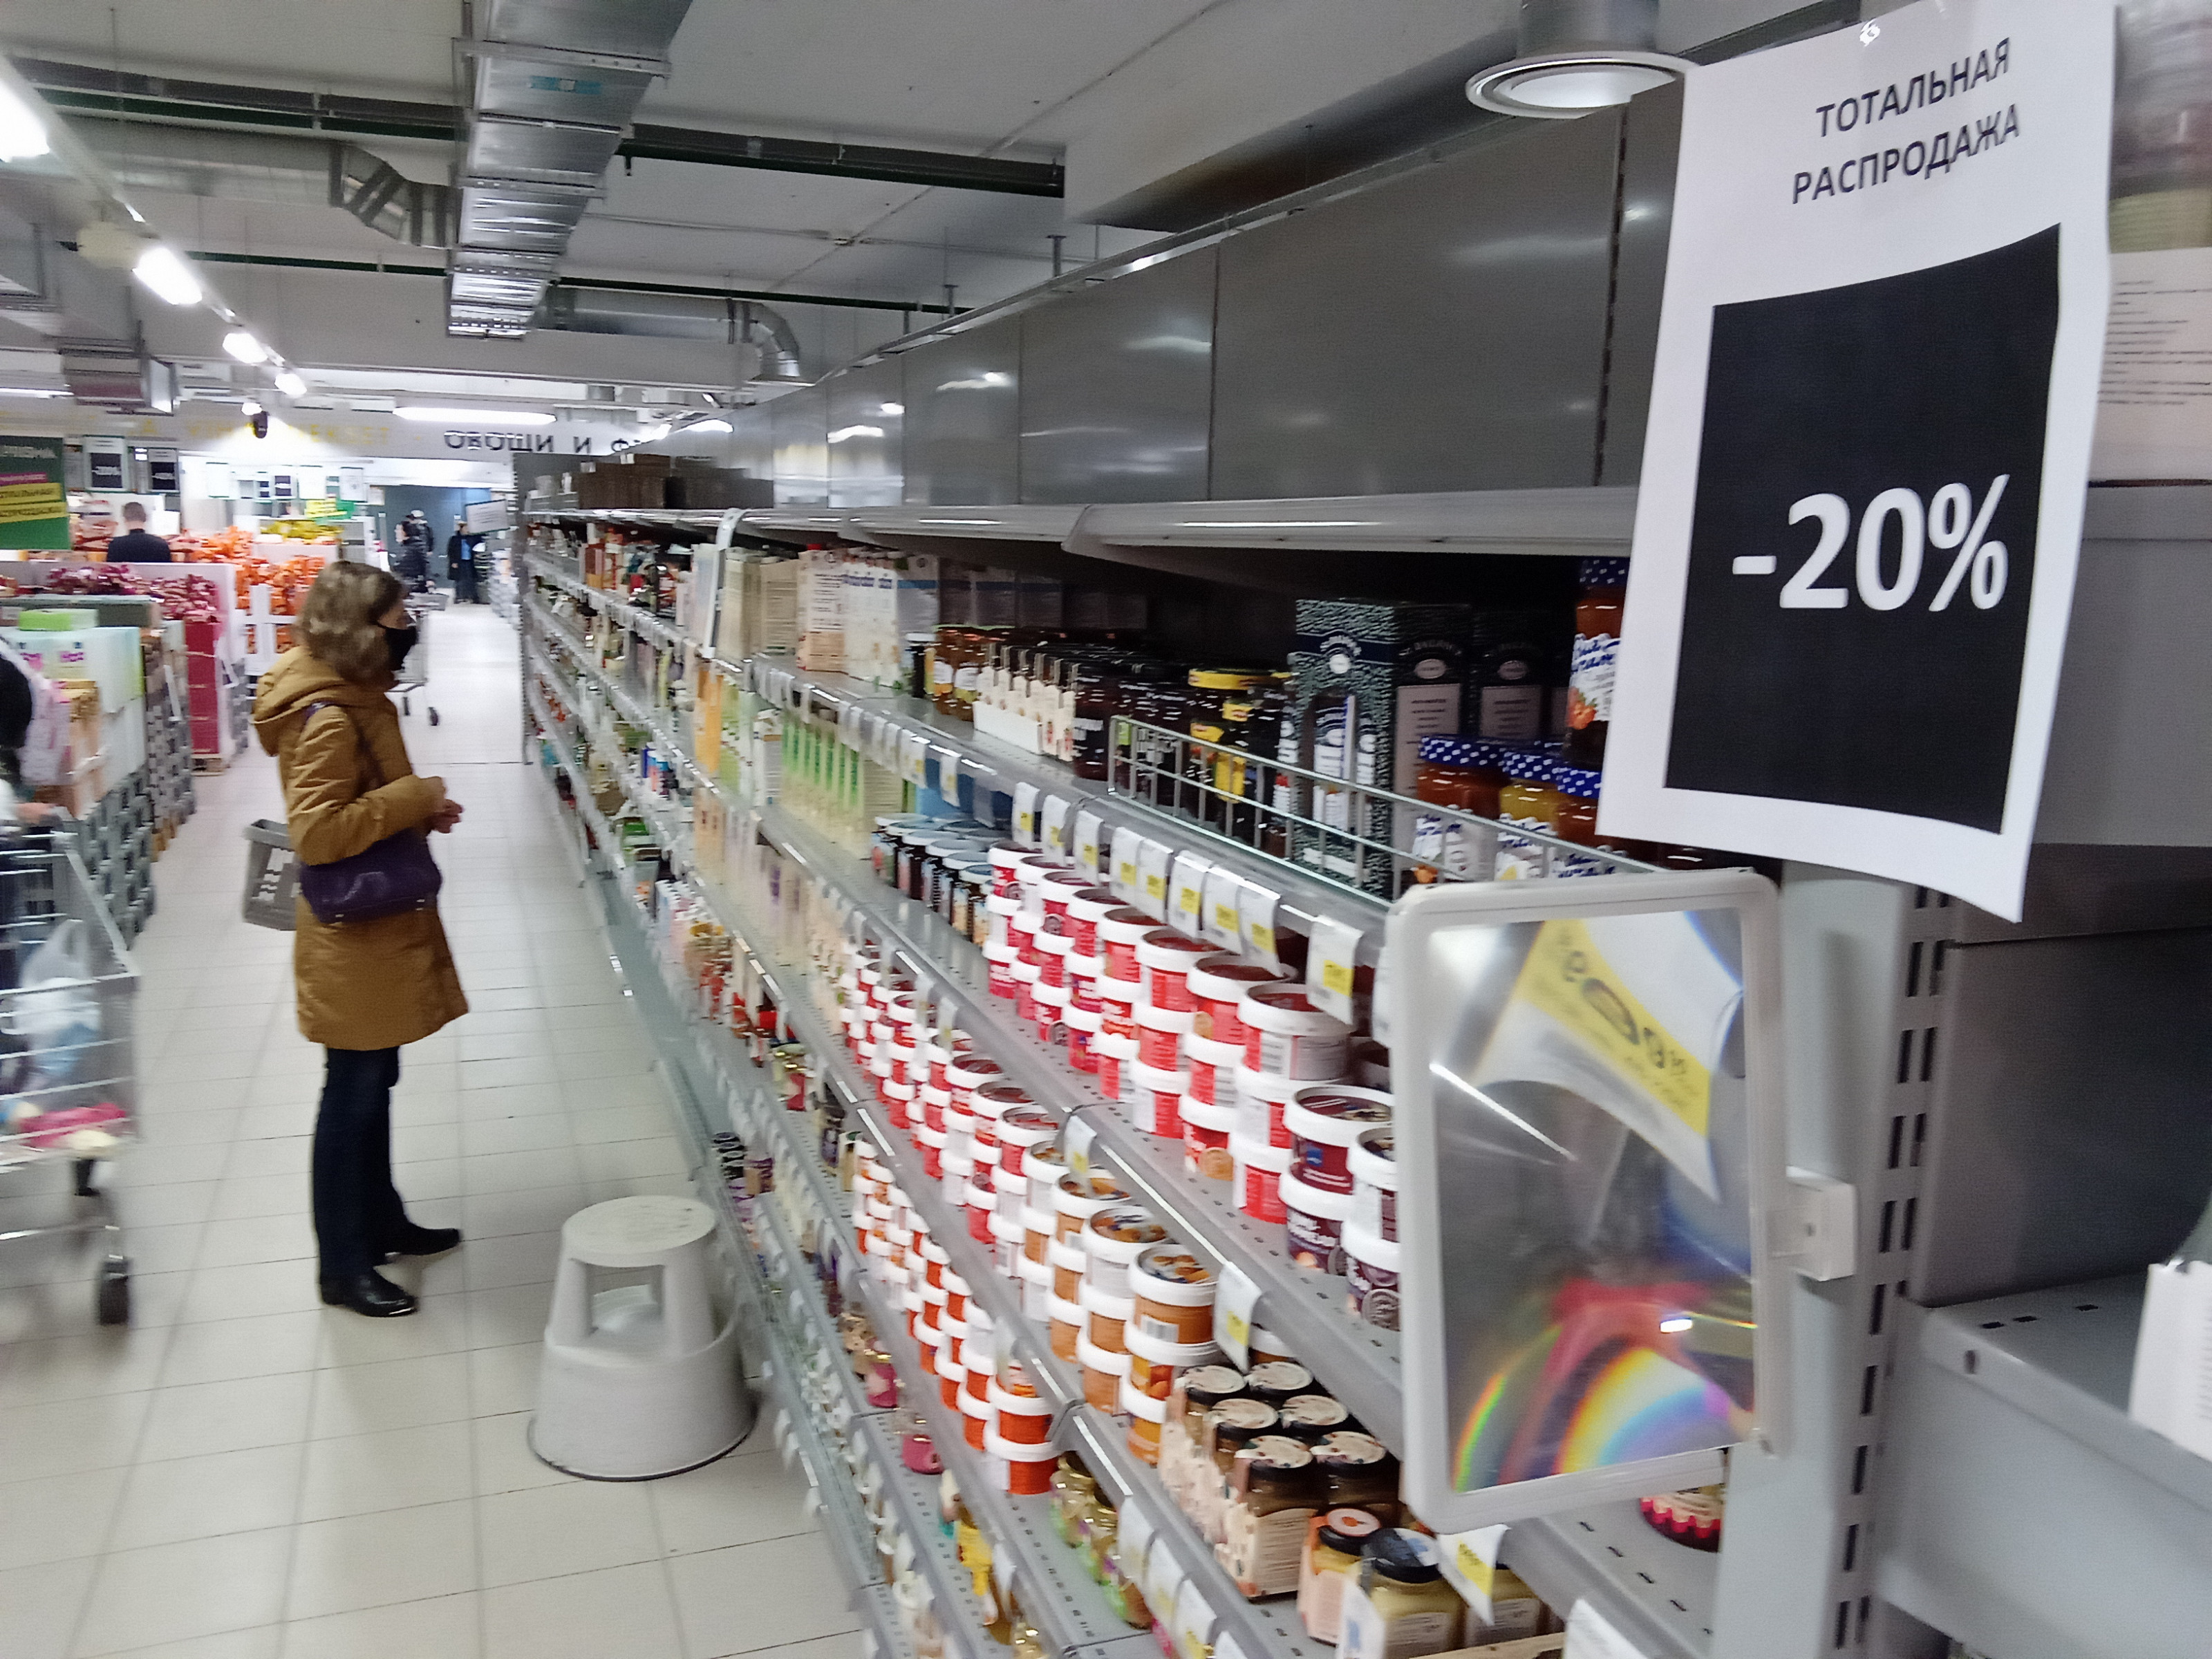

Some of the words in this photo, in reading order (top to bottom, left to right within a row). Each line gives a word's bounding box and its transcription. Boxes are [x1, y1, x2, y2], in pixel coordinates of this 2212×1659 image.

[1816, 37, 2009, 137] ТОТАЛЬНАЯ
[1792, 104, 2019, 204] РАСПРОДАЖА
[444, 430, 554, 452] ОВОЩИ
[574, 436, 592, 453] И
[1733, 474, 2009, 611] -20%
